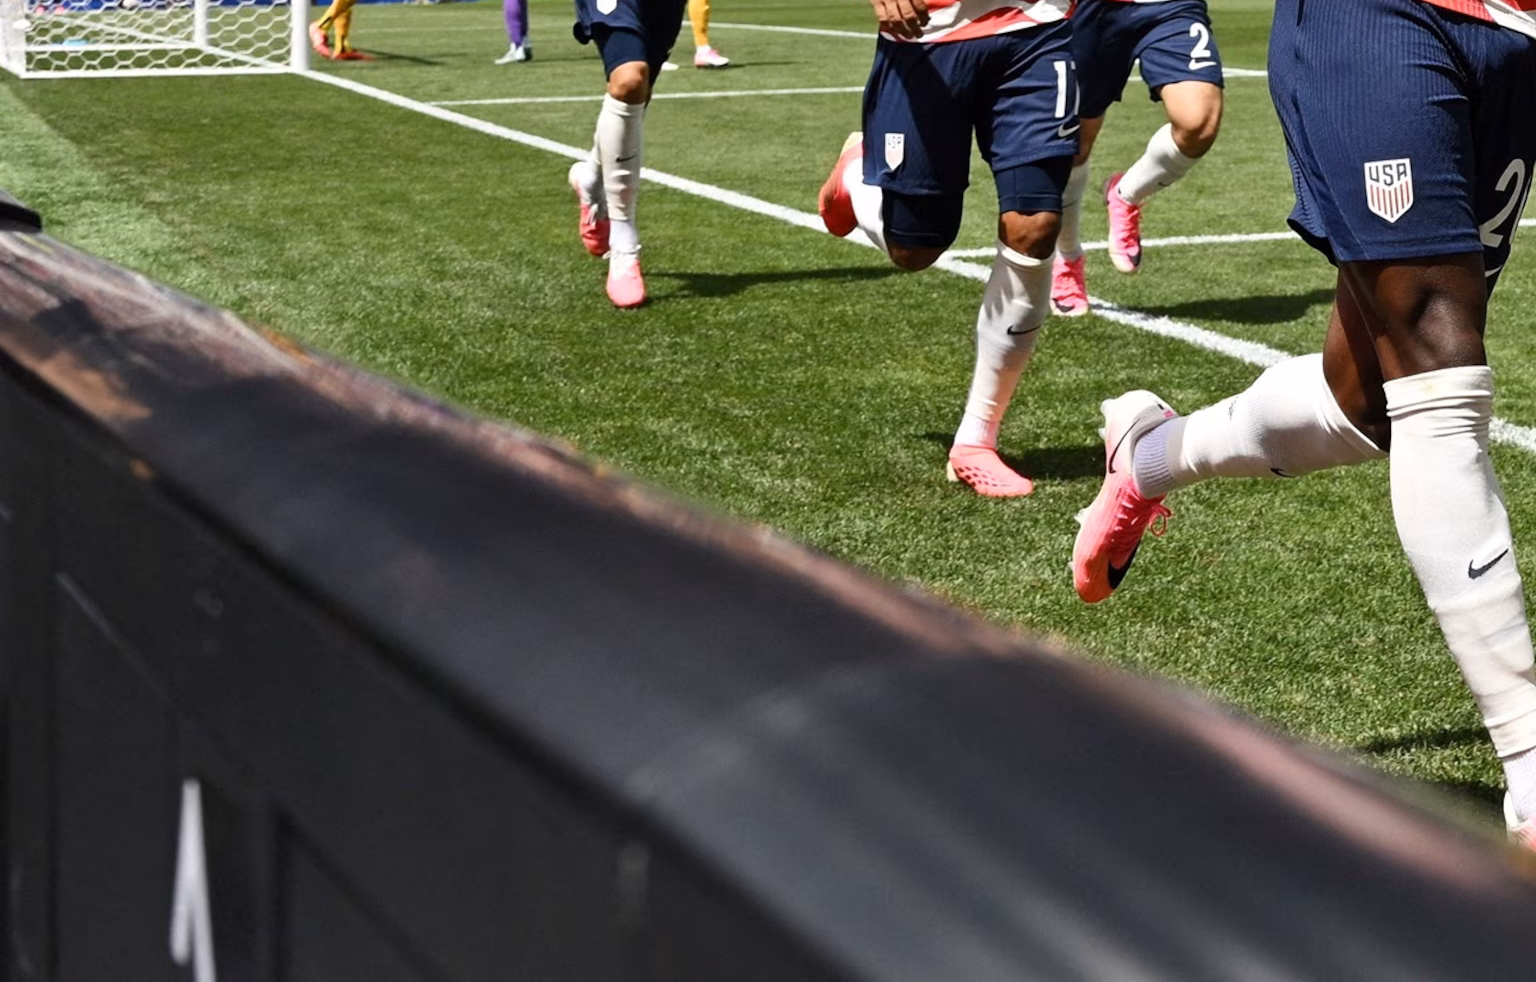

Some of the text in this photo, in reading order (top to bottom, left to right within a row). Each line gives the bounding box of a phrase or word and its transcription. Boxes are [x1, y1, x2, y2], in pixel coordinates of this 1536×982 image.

[1189, 22, 1211, 58] 2
[1053, 60, 1080, 118] 1
[1369, 162, 1408, 187] USA
[1479, 158, 1532, 248] 2
